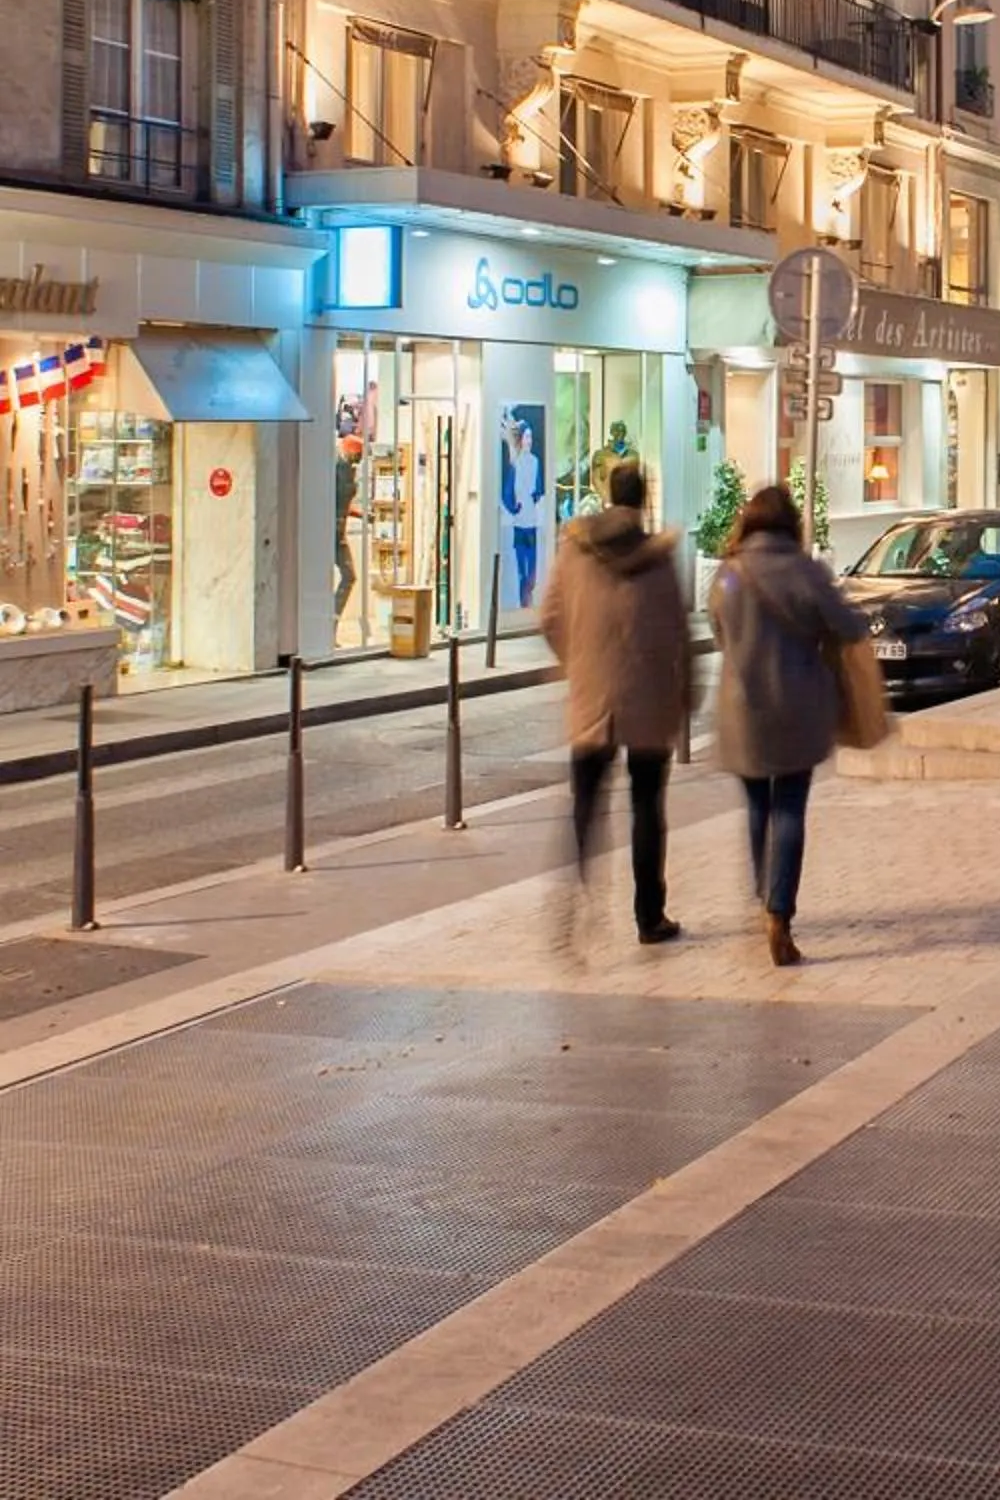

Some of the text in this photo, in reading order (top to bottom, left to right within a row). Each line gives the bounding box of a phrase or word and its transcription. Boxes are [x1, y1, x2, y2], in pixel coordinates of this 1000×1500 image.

[502, 273, 578, 310] odlo
[875, 310, 905, 347] des
[912, 311, 982, 354] Artistes
